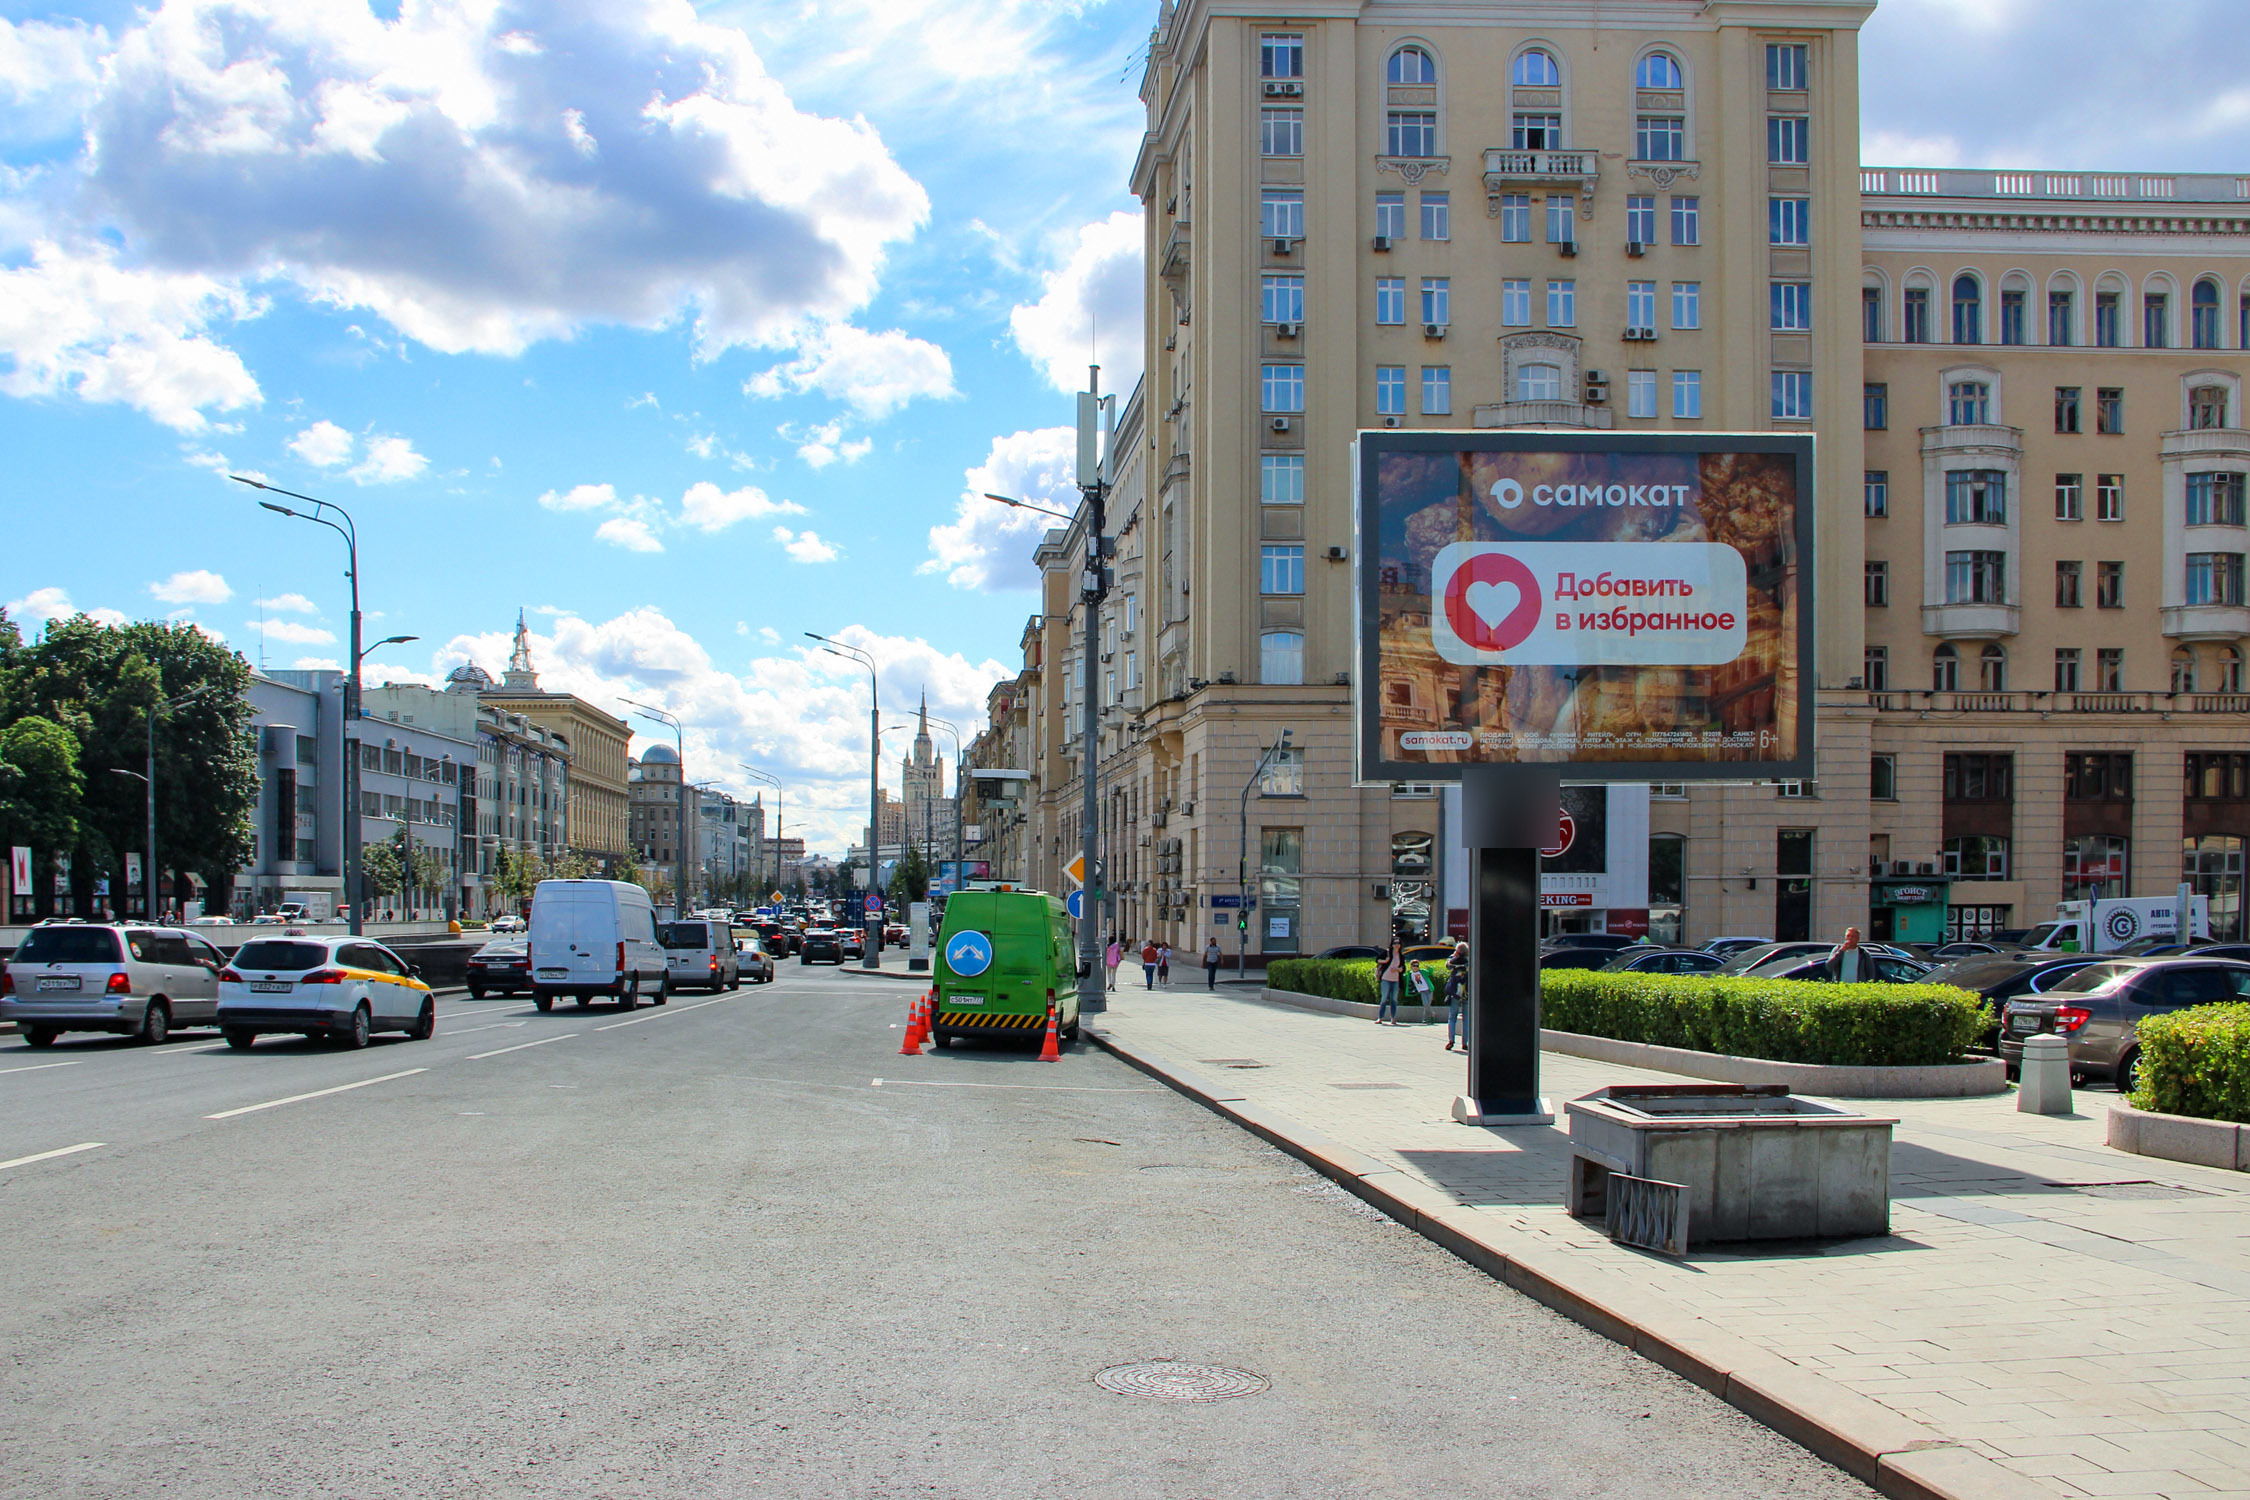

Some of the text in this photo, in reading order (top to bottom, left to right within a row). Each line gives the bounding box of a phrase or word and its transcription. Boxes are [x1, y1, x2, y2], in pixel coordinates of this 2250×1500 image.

[1532, 484, 1690, 507] самокат
[1554, 571, 1694, 601] Добавить
[1555, 606, 1736, 637] в избранное
[1405, 734, 1468, 745] samokat.ru
[1760, 729, 1779, 749] 6+
[1894, 887, 1928, 897] ЭГОИСТ
[1540, 895, 1577, 905] EKING
[2150, 909, 2170, 919] АВТО
